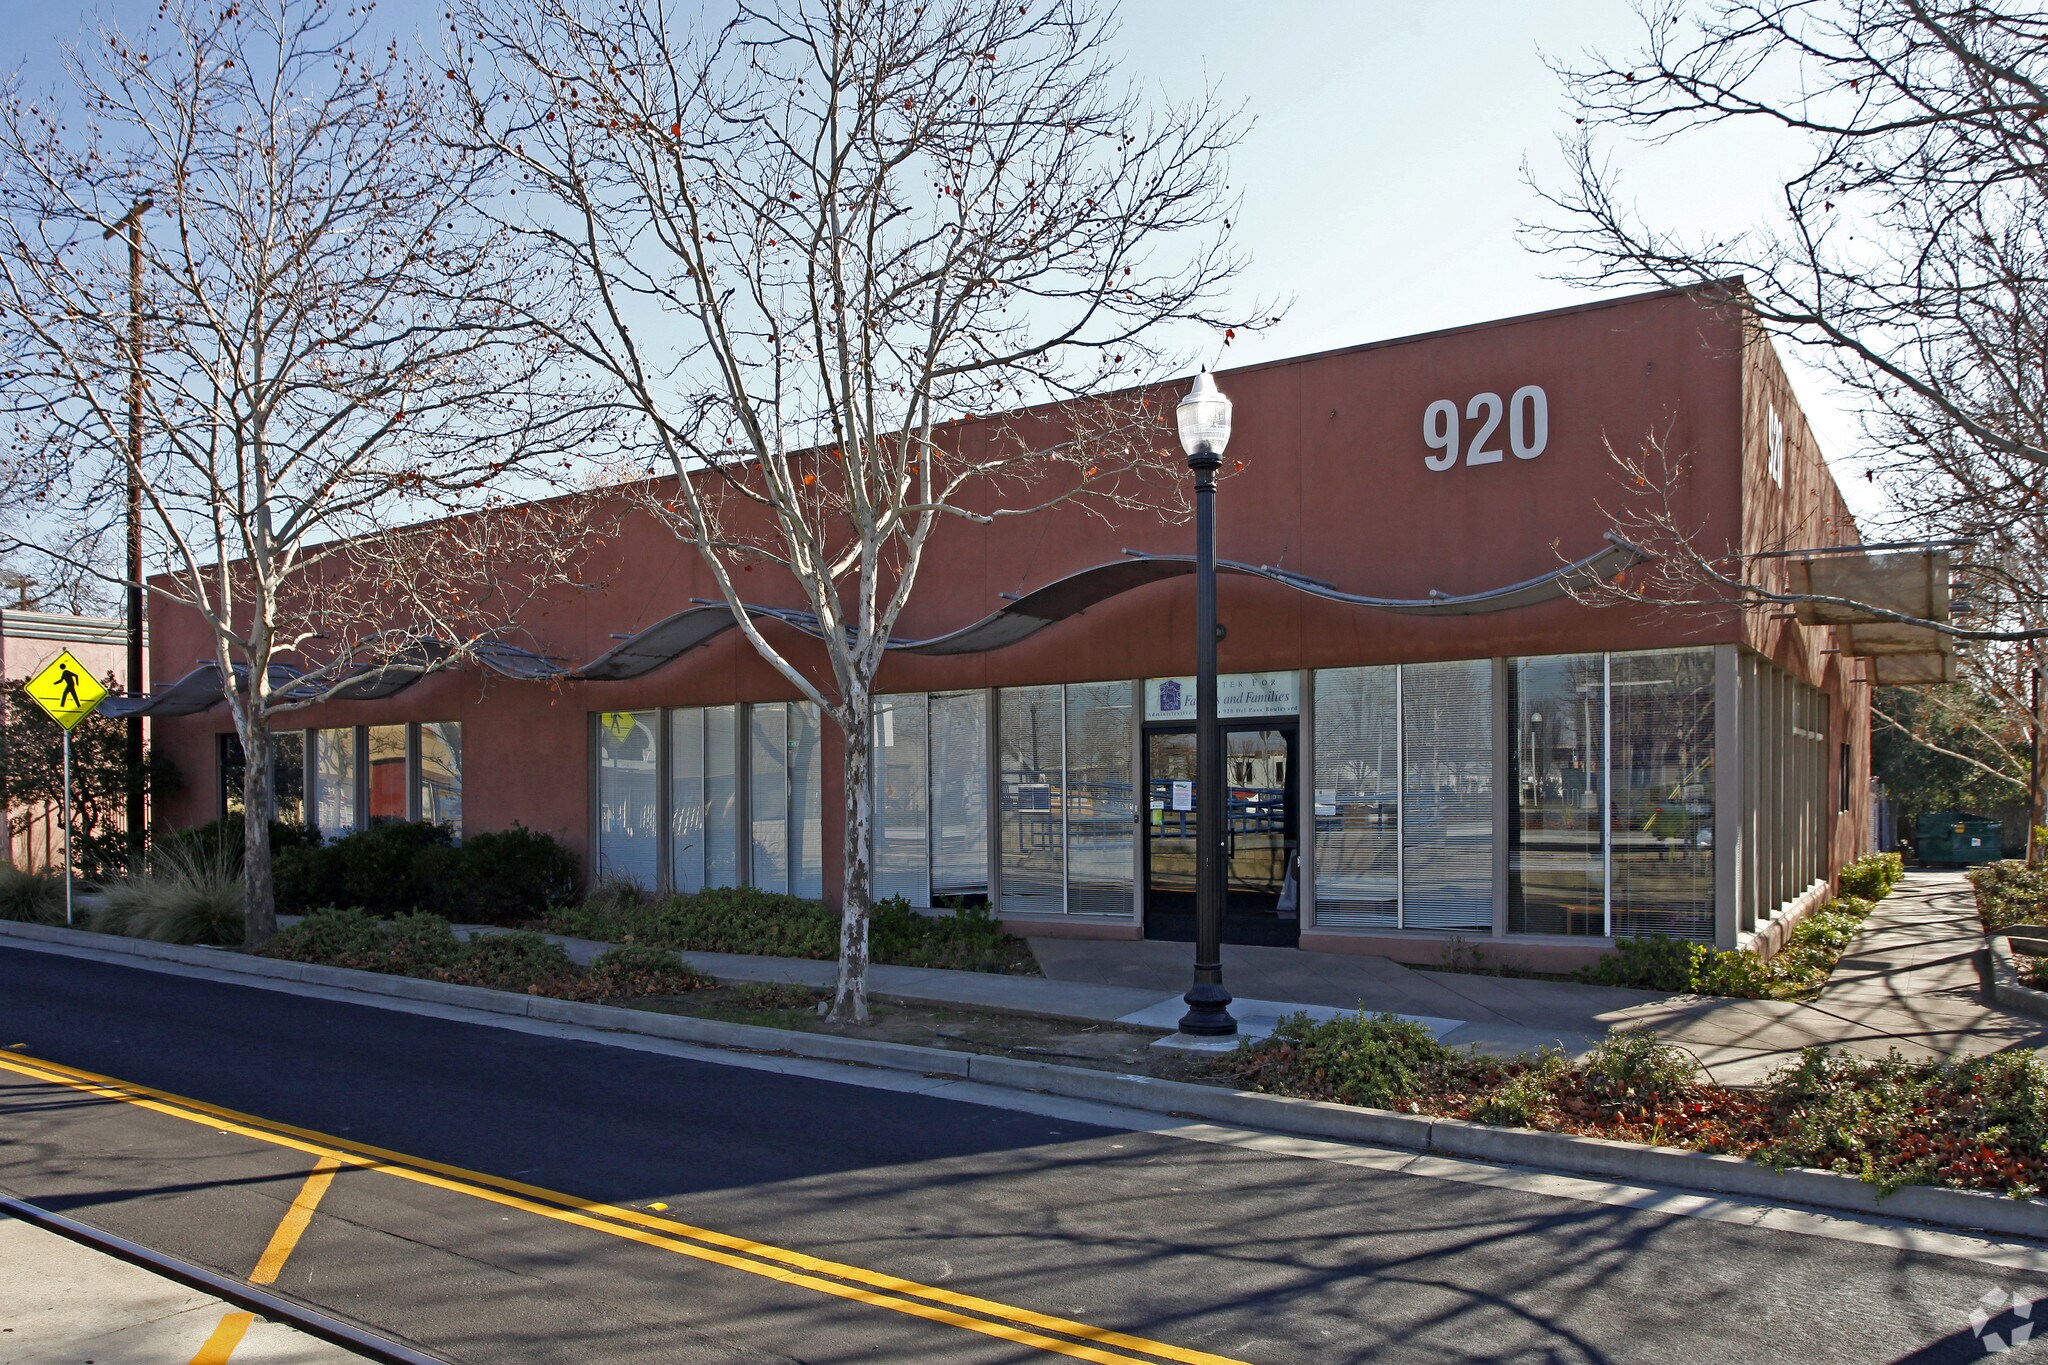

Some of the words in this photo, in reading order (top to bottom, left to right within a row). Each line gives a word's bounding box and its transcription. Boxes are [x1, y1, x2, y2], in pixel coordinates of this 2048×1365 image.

[1422, 384, 1549, 472] 920
[1768, 403, 1783, 489] 920
[1223, 692, 1244, 704] and
[1245, 690, 1290, 703] Families
